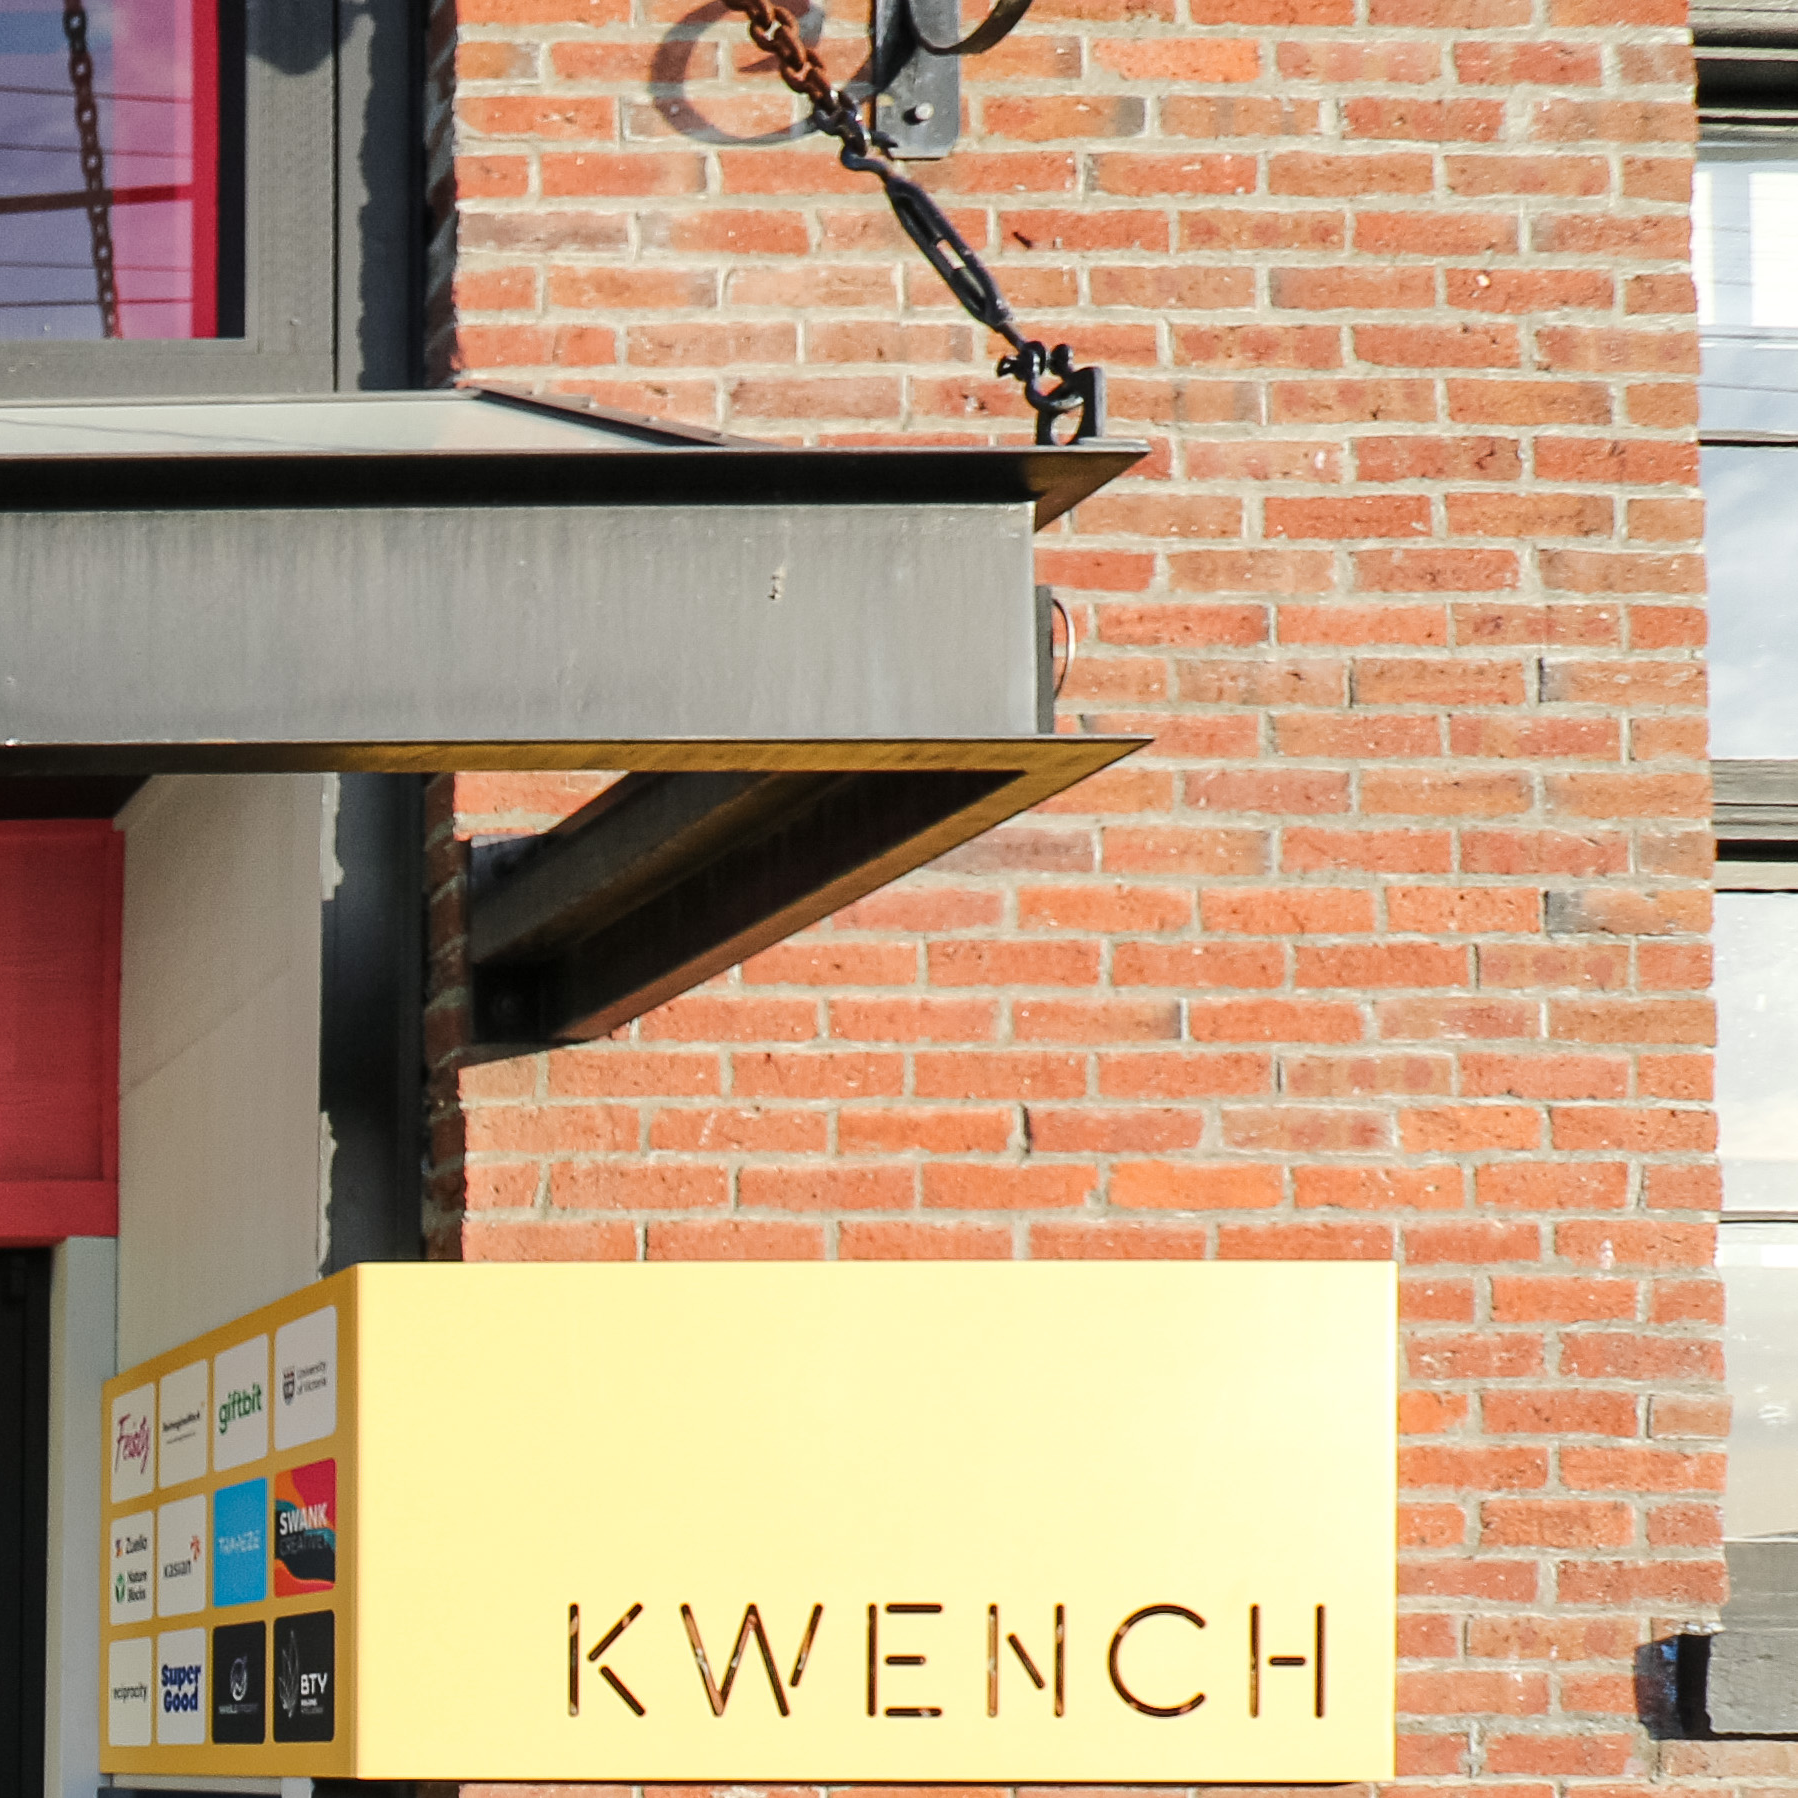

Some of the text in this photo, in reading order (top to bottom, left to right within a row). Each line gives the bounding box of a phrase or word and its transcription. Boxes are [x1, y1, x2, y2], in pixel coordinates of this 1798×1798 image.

[219, 1382, 262, 1435] giftbit
[279, 1502, 328, 1536] SWANK
[567, 1601, 1327, 1720] KWENCH
[161, 1664, 202, 1692] Super
[300, 1672, 328, 1695] BTY
[164, 1686, 199, 1714] Good
